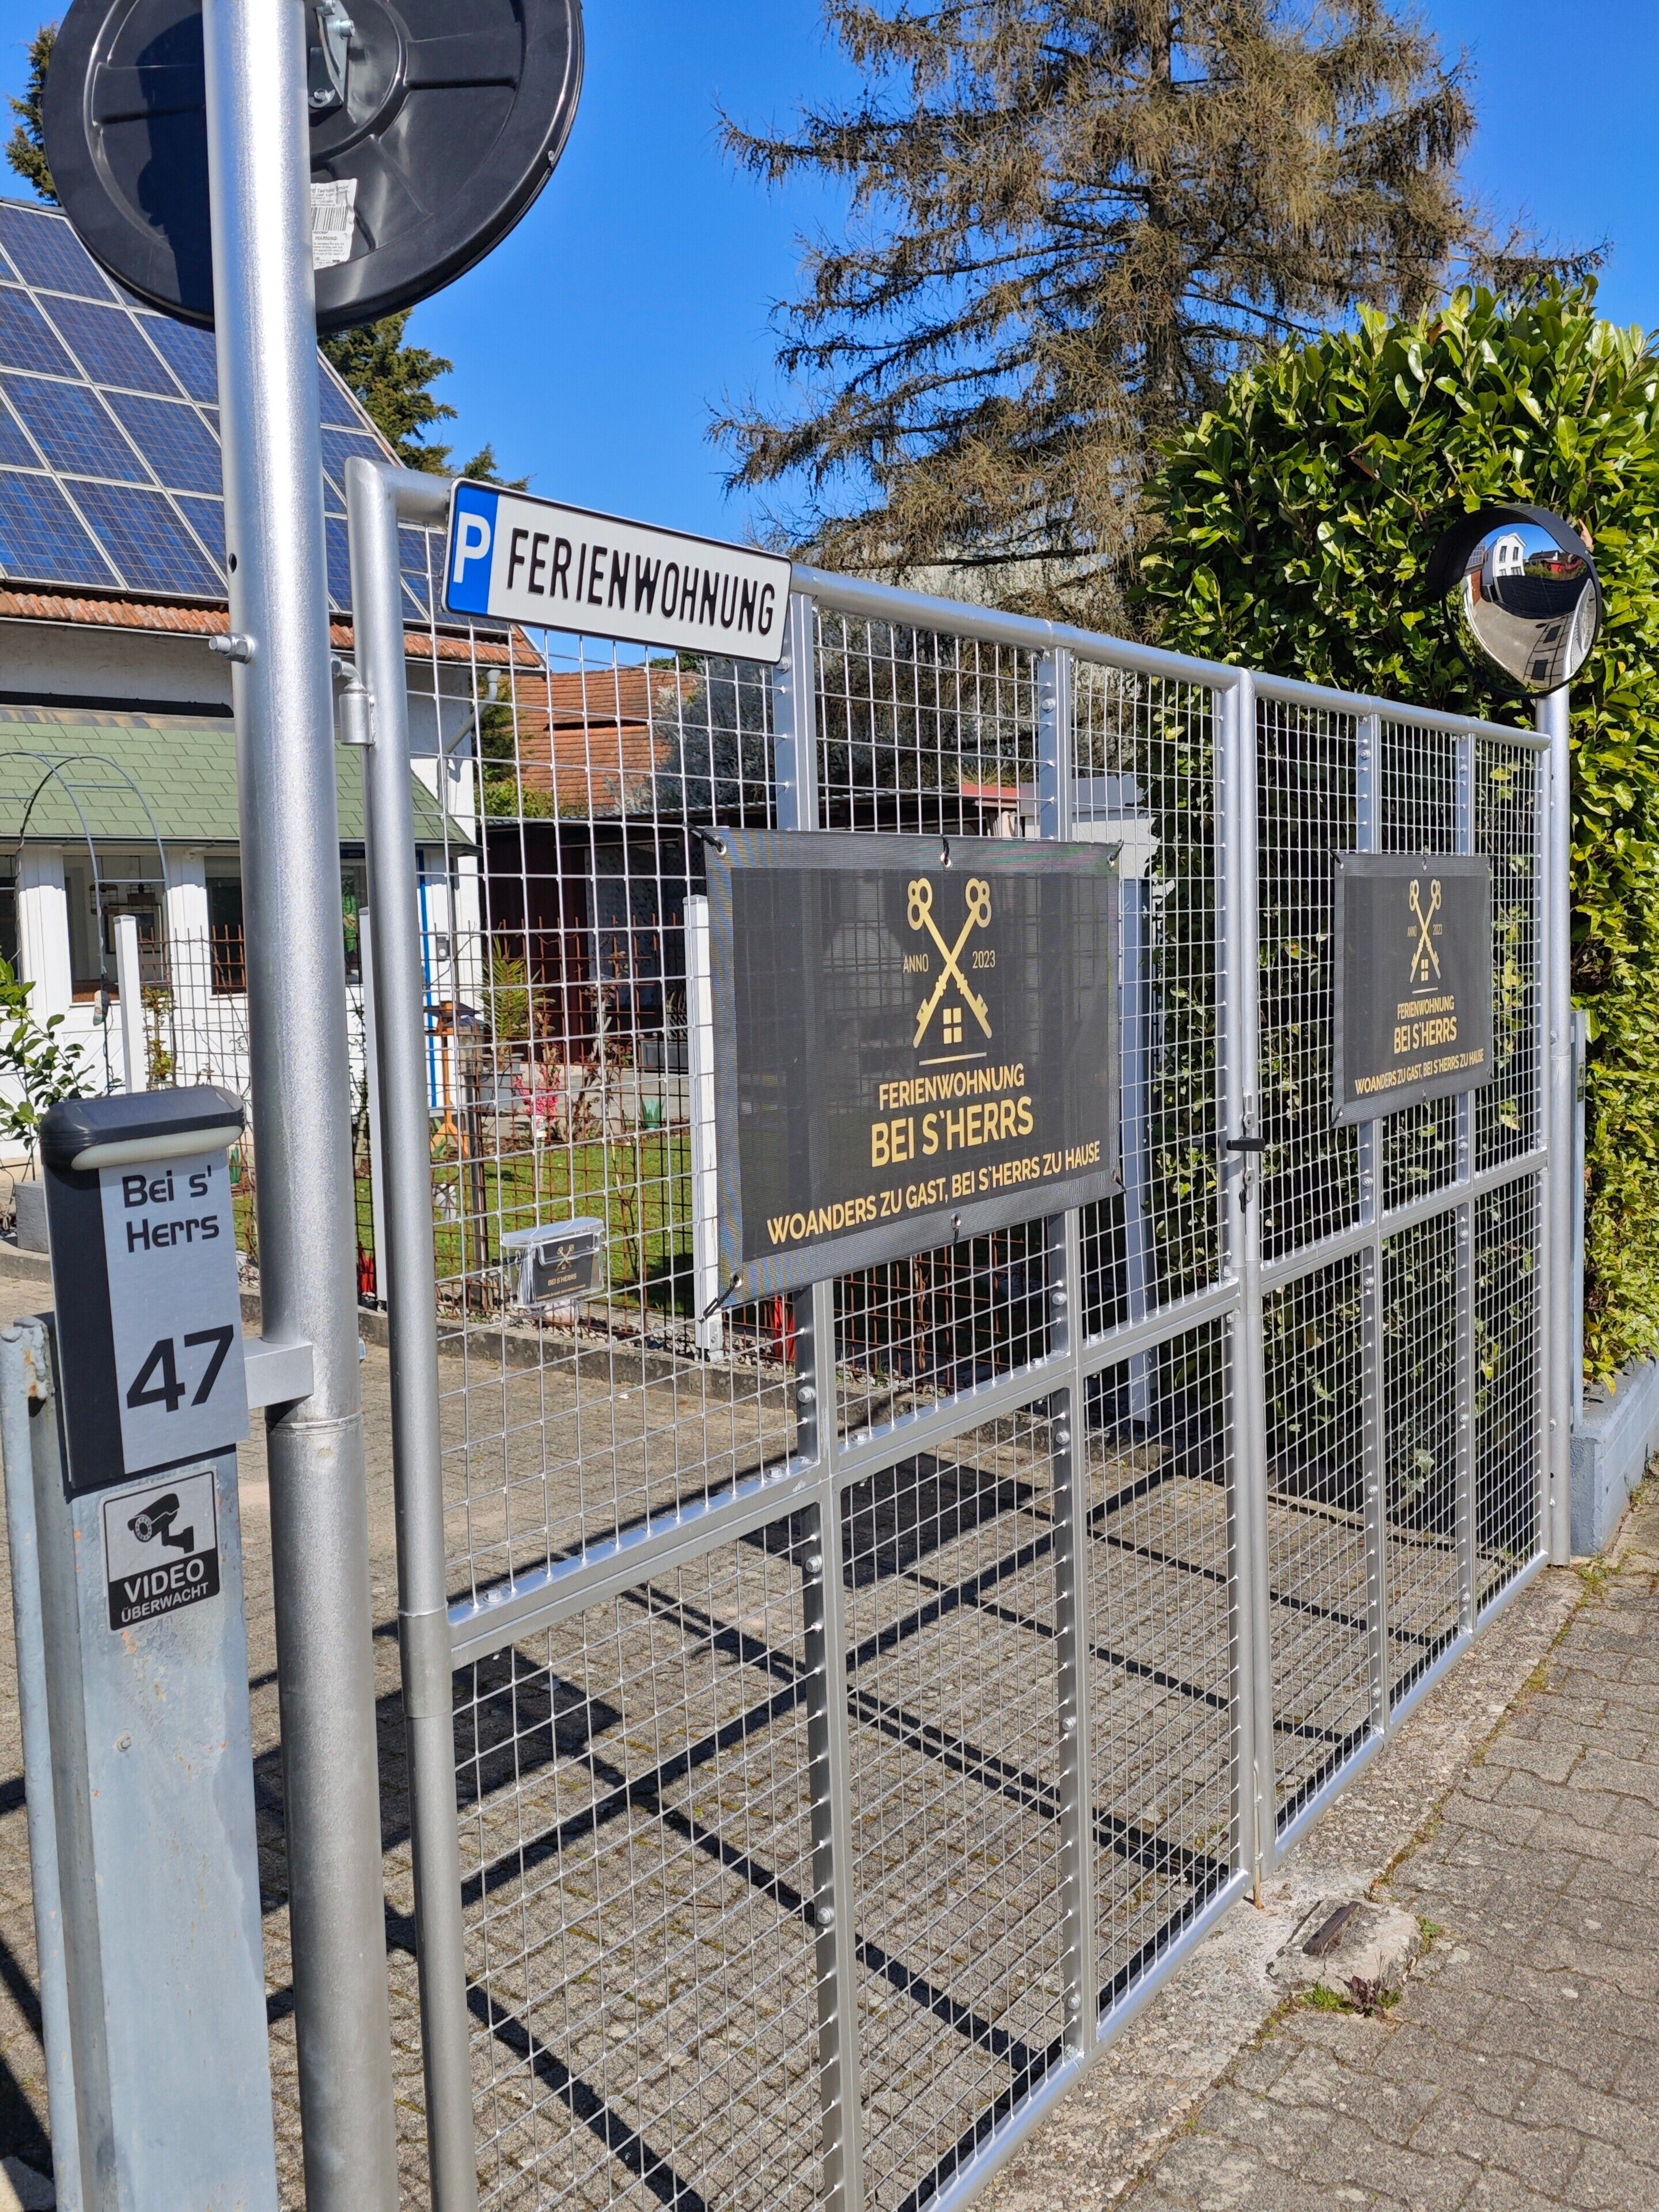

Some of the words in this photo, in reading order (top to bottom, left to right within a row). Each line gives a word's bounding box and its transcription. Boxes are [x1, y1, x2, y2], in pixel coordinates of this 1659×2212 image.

[453, 511, 491, 583] P
[507, 528, 775, 635] FERIENWOHNUNG
[903, 953, 929, 974] ANNO
[972, 950, 995, 968] 2023
[1397, 995, 1455, 1020] FERIENWOHNUNG
[1394, 1025, 1410, 1054] BEI
[879, 1063, 1025, 1111] FERIENWOHNUNG
[1355, 1070, 1397, 1095] WOANDERS
[1397, 1068, 1406, 1084] ZU
[1406, 1064, 1423, 1080] GAST,
[1423, 1060, 1433, 1077] BEI
[1460, 1053, 1468, 1067] ZU
[1469, 1048, 1484, 1065] HAUSE
[872, 1117, 915, 1168] BEI
[122, 1169, 174, 1208] Bei
[767, 1195, 877, 1245] WOANDERS
[880, 1188, 902, 1217] ZU
[906, 1177, 948, 1209] GAST,
[952, 1171, 975, 1198] BEI
[1043, 1152, 1062, 1176] ZU
[1065, 1141, 1100, 1171] HAUSE
[126, 1215, 219, 1253] Herrs
[126, 1324, 233, 1413] 47
[121, 1582, 209, 1623] ÜBERWACHT
[124, 1559, 204, 1603] VIDEO
